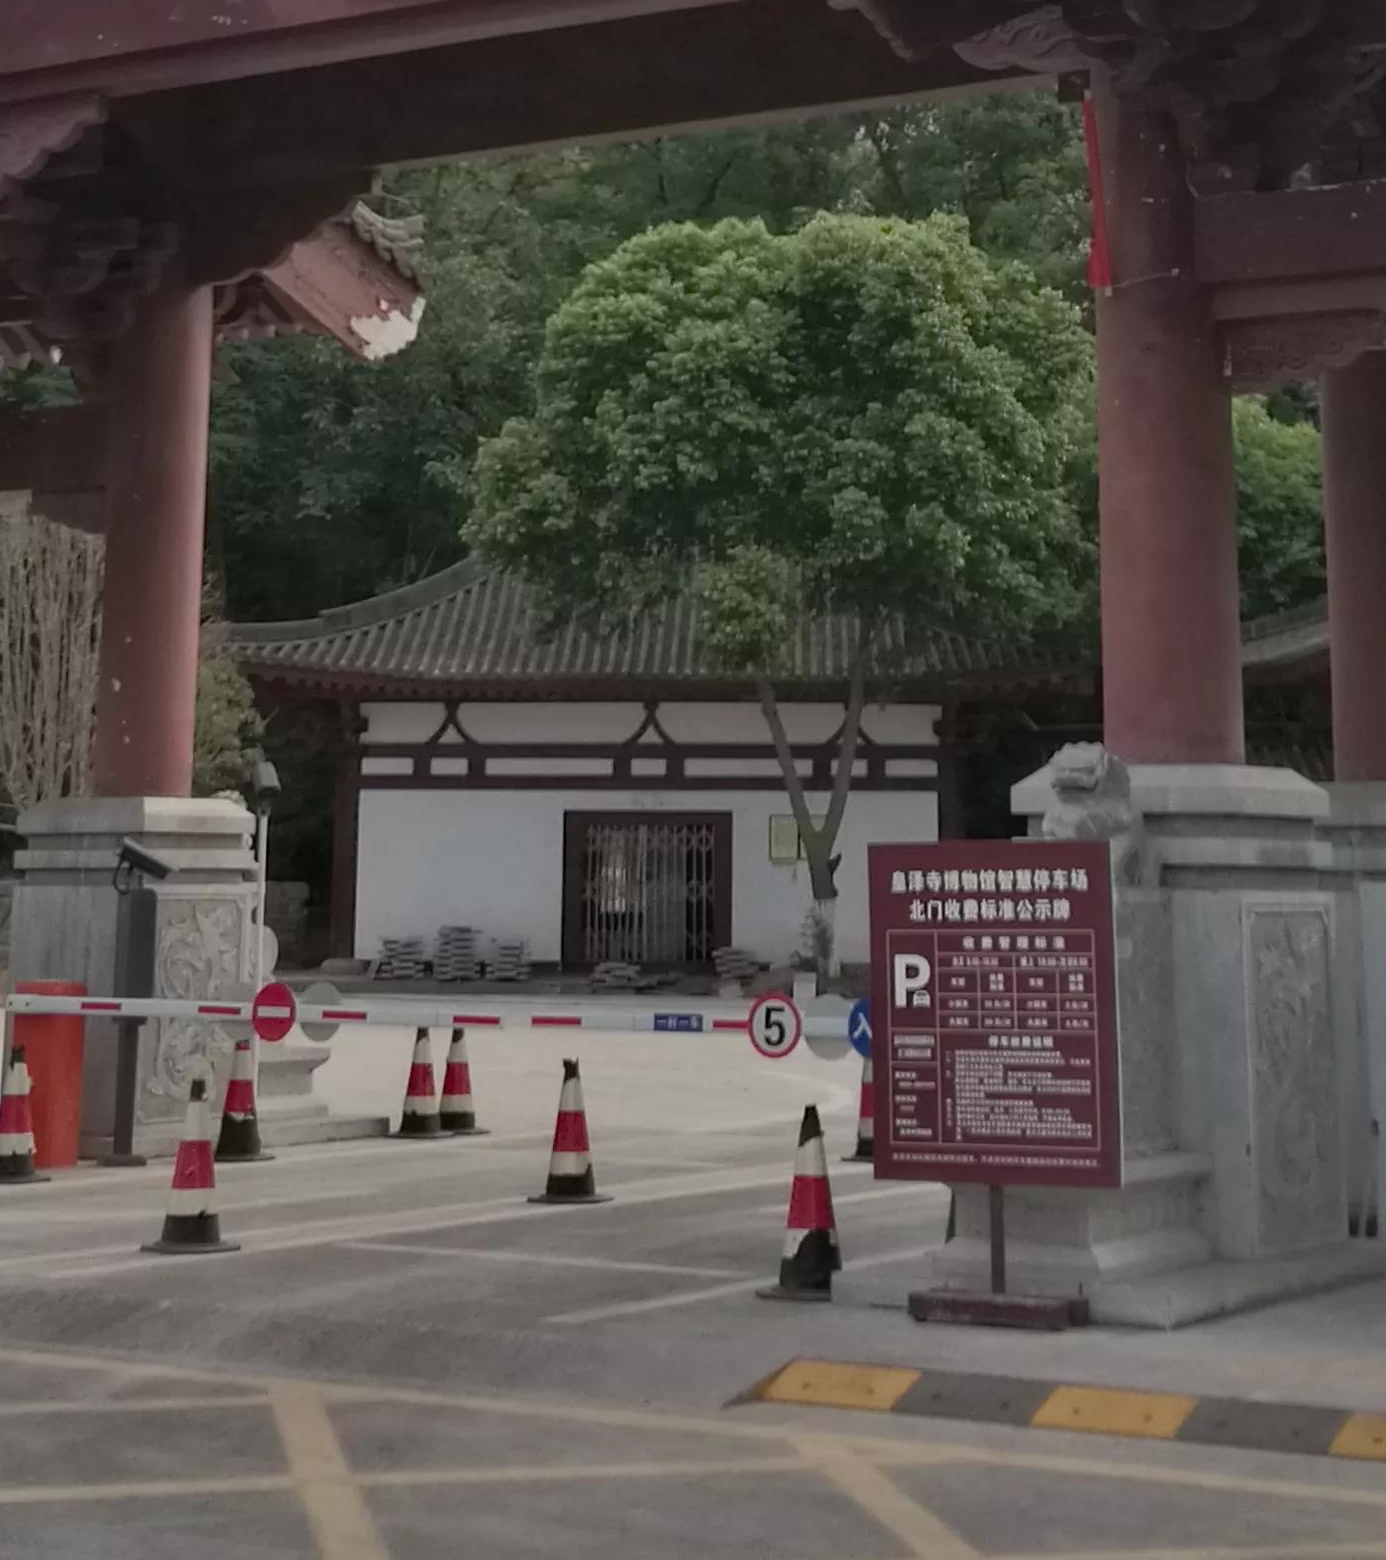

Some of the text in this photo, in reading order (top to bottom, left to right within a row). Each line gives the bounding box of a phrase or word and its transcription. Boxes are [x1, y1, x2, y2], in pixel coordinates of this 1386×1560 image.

[890, 868, 1090, 894] 皇泽寺博物馆智慧停车场
[909, 897, 1071, 923] 北门收费标准公示牌
[894, 954, 931, 1008] P
[763, 1005, 787, 1047] 5
